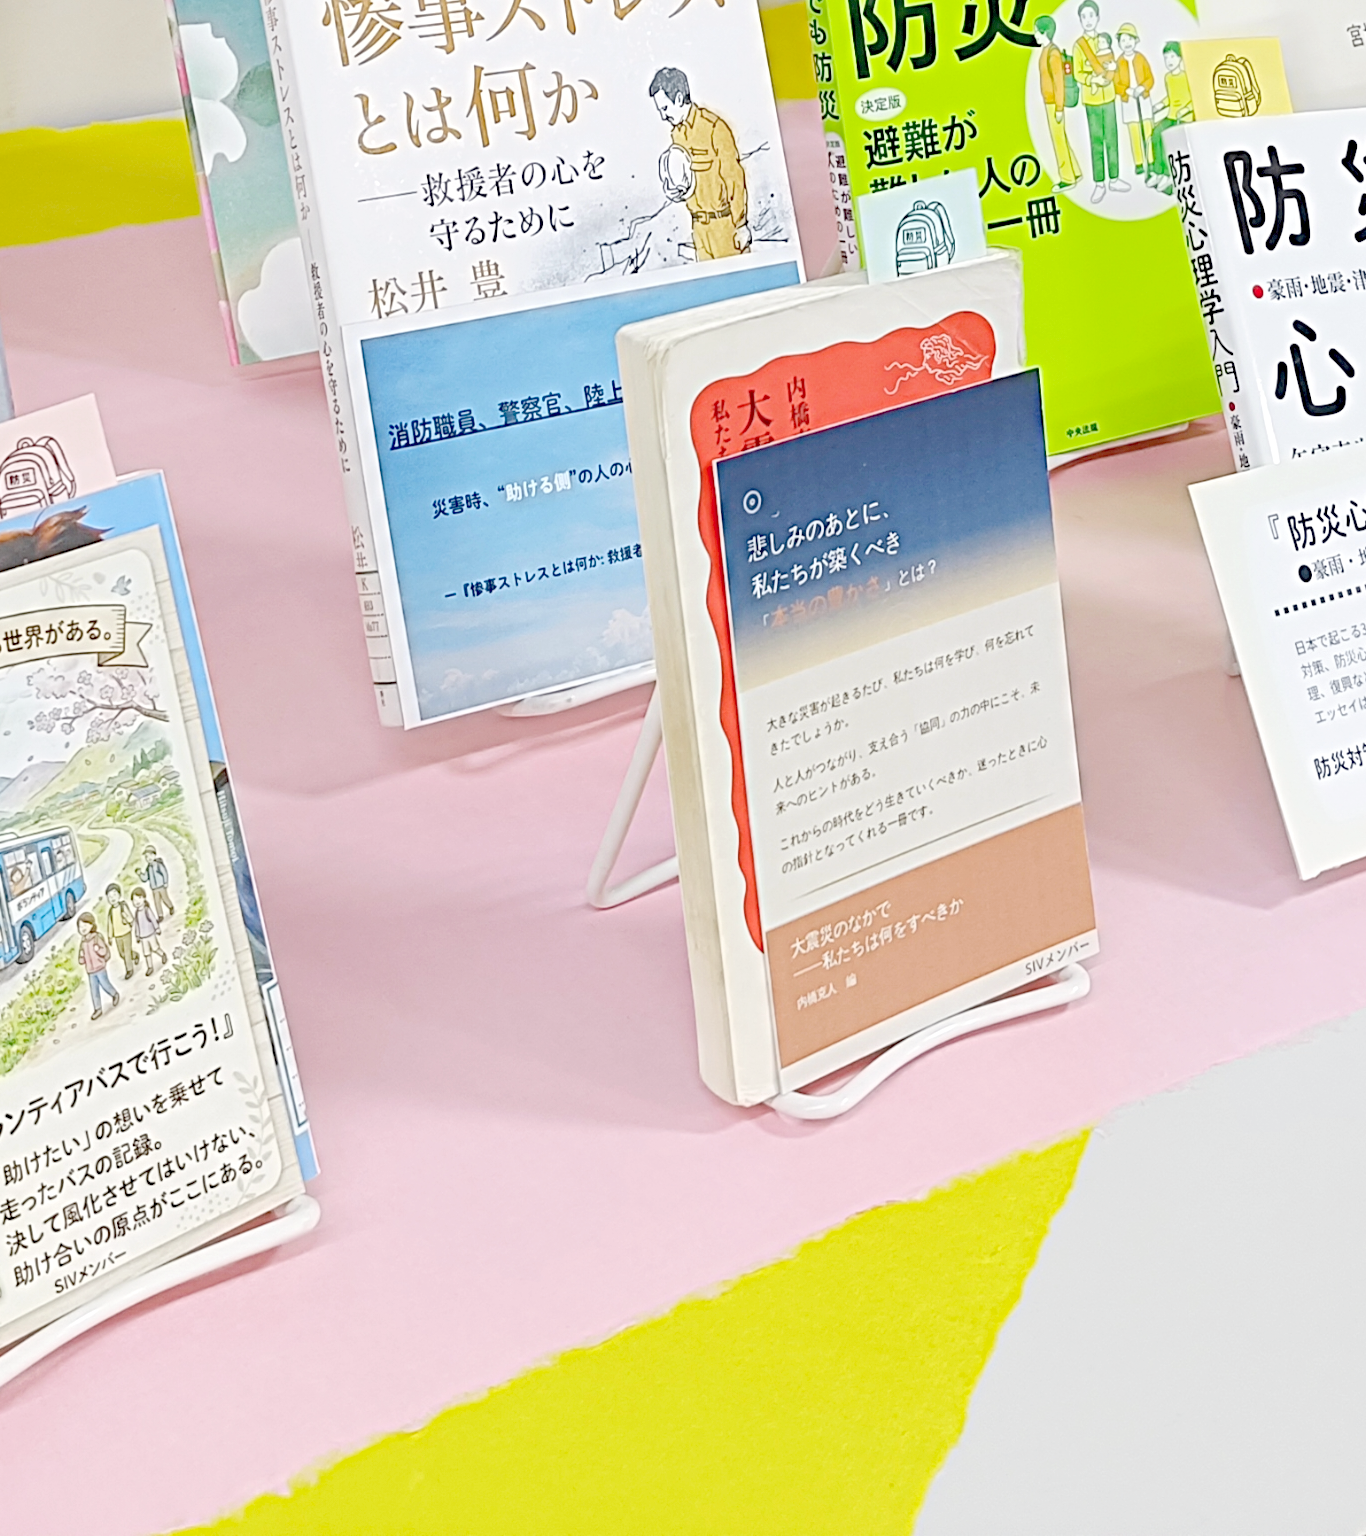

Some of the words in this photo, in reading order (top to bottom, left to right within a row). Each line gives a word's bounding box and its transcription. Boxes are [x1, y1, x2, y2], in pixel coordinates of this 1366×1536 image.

[353, 61, 600, 156] とは何か
[860, 95, 902, 115] 決定版
[863, 110, 979, 171] 避難が
[429, 203, 574, 251] 守るために
[987, 195, 1062, 239] 一冊
[369, 271, 448, 319] 松井
[469, 260, 508, 301] 豊
[1167, 150, 1241, 399] 防災心理学入門
[9, 472, 35, 487] 防災
[747, 500, 890, 562] 悲しみのあとに、
[751, 531, 901, 599] 私たちが築くべき
[770, 718, 850, 756] きたでしょうか。
[775, 769, 878, 816] 来へのヒントがある。
[782, 807, 935, 874] の指針となってくれる一冊です。
[790, 899, 892, 959] 大震災のなかで
[1025, 940, 1091, 976] SIVメンバー
[0, 1133, 164, 1225] 走ったバスの記録。
[6, 1123, 257, 1257] 決して風化させてはいけない、
[13, 1158, 265, 1288] 助け合いの原点がここにある。
[54, 1250, 128, 1295] SIVメンバー
